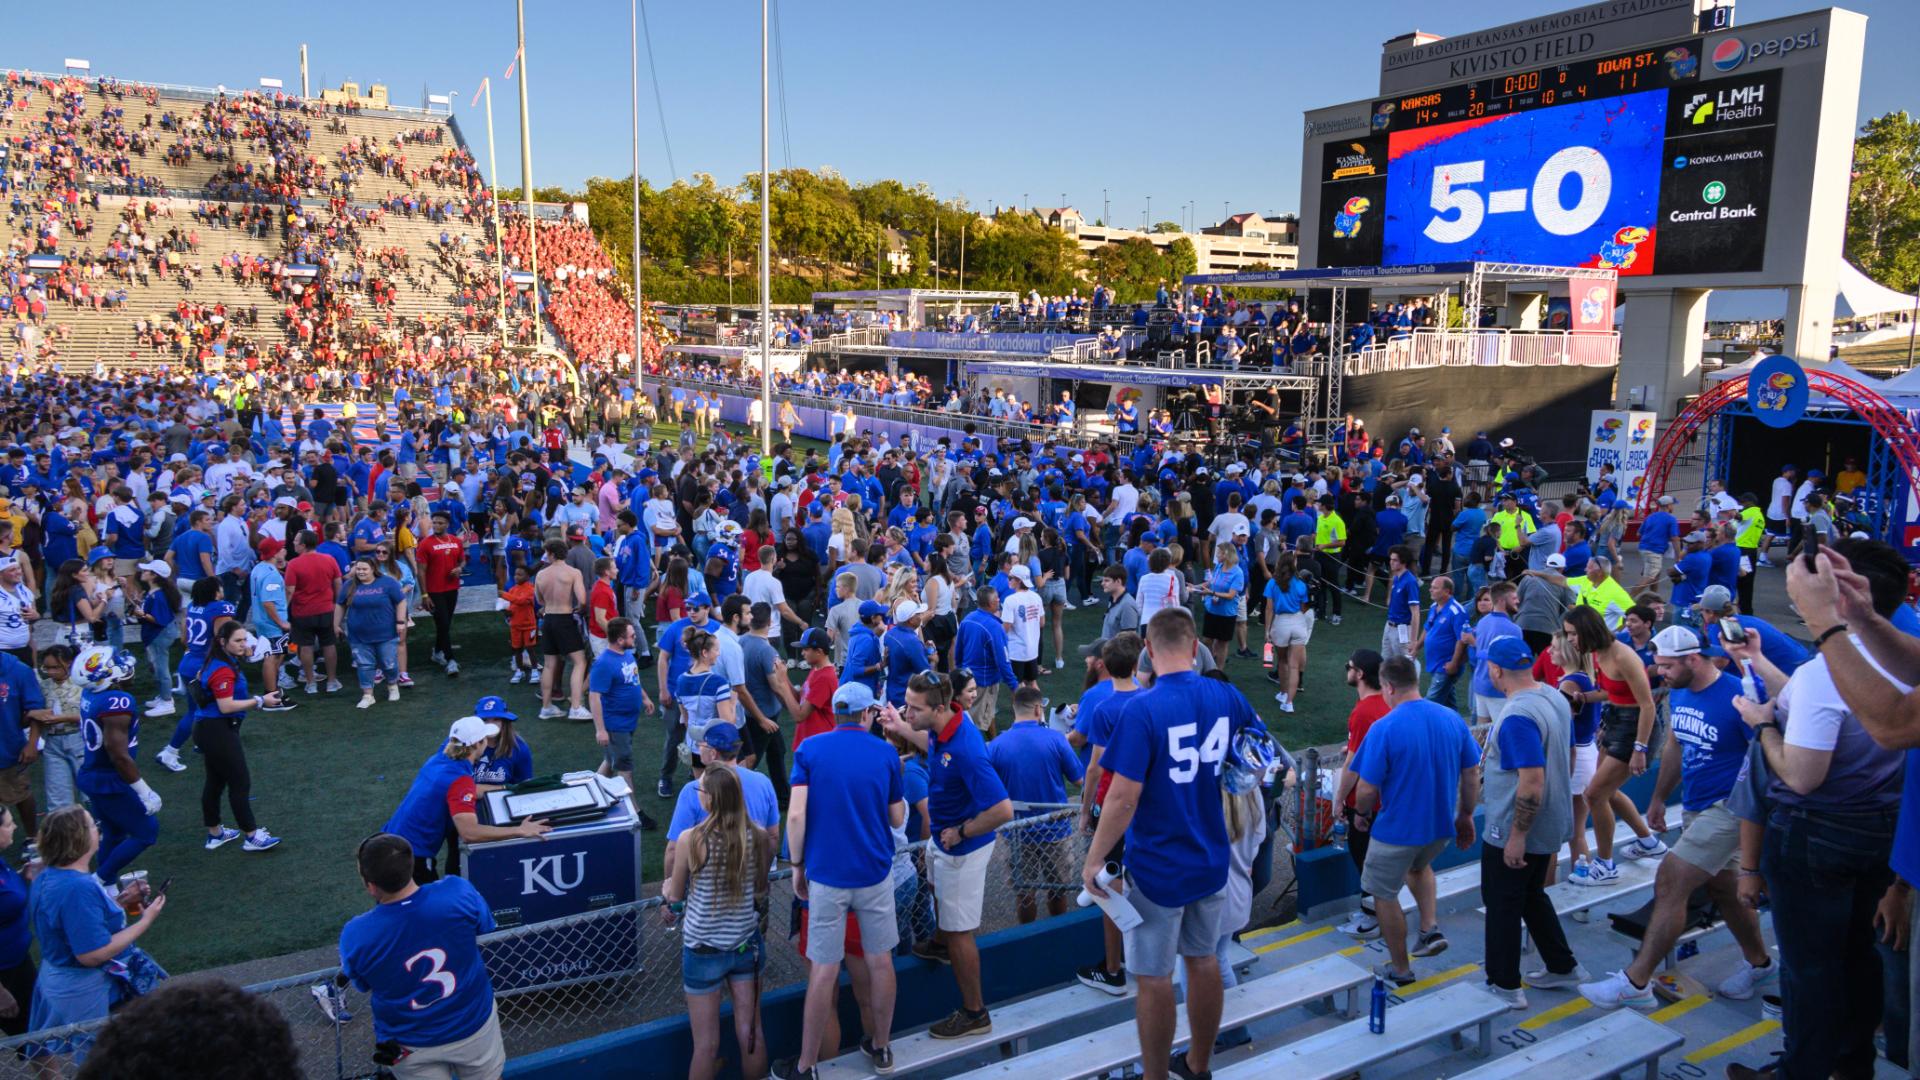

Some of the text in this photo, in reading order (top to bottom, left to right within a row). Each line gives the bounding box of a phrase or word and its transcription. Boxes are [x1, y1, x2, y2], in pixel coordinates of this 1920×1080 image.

[1714, 8, 1726, 27] 0
[1389, 0, 1679, 66] DAVID BOOTH KANSAS MEMORIAL STADI
[1747, 28, 1819, 64] pepsi
[1449, 32, 1595, 78] KIVISTO FIELD
[1596, 52, 1658, 76] IOWA ST.
[1504, 72, 1539, 94] 0:00
[1558, 72, 1567, 84] 0
[1619, 72, 1638, 91] 11
[1469, 88, 1477, 100] 3
[1540, 89, 1555, 105] 10
[1577, 84, 1588, 97] 4
[1717, 84, 1765, 108] LMH
[1401, 93, 1442, 111] KANSAS
[1468, 102, 1484, 118] 20
[1508, 96, 1513, 111] 1
[1416, 109, 1429, 124] 14
[1715, 103, 1763, 122] Health
[1336, 154, 1365, 165] KANSAS
[1340, 158, 1371, 168] LOTTERY
[1689, 150, 1764, 166] KONICA MINOLTA
[1422, 145, 1613, 245] 5-0
[1669, 204, 1757, 222] Central Bank
[1207, 272, 1280, 283] Meritrust Touchdown Club
[1341, 264, 1436, 277] Meritrust Touchdown Club
[936, 334, 981, 349] Meritrust
[983, 335, 1041, 351] Touchdown
[1103, 372, 1187, 386] Meritrust Touchdown Club
[1593, 447, 1621, 460] ROCK
[1629, 450, 1649, 461] ROCK
[1088, 460, 1097, 475] 5
[224, 473, 233, 491] 5
[516, 539, 523, 548] 3
[353, 586, 384, 596] ANSAS
[222, 604, 236, 614] 32
[108, 696, 130, 710] 20
[1675, 706, 1705, 720] KANSAS
[1168, 716, 1230, 784] 54
[519, 851, 588, 896] KU
[521, 958, 593, 979] FOOTBALL
[403, 947, 456, 1011] 3
[1497, 1028, 1538, 1050] 03
